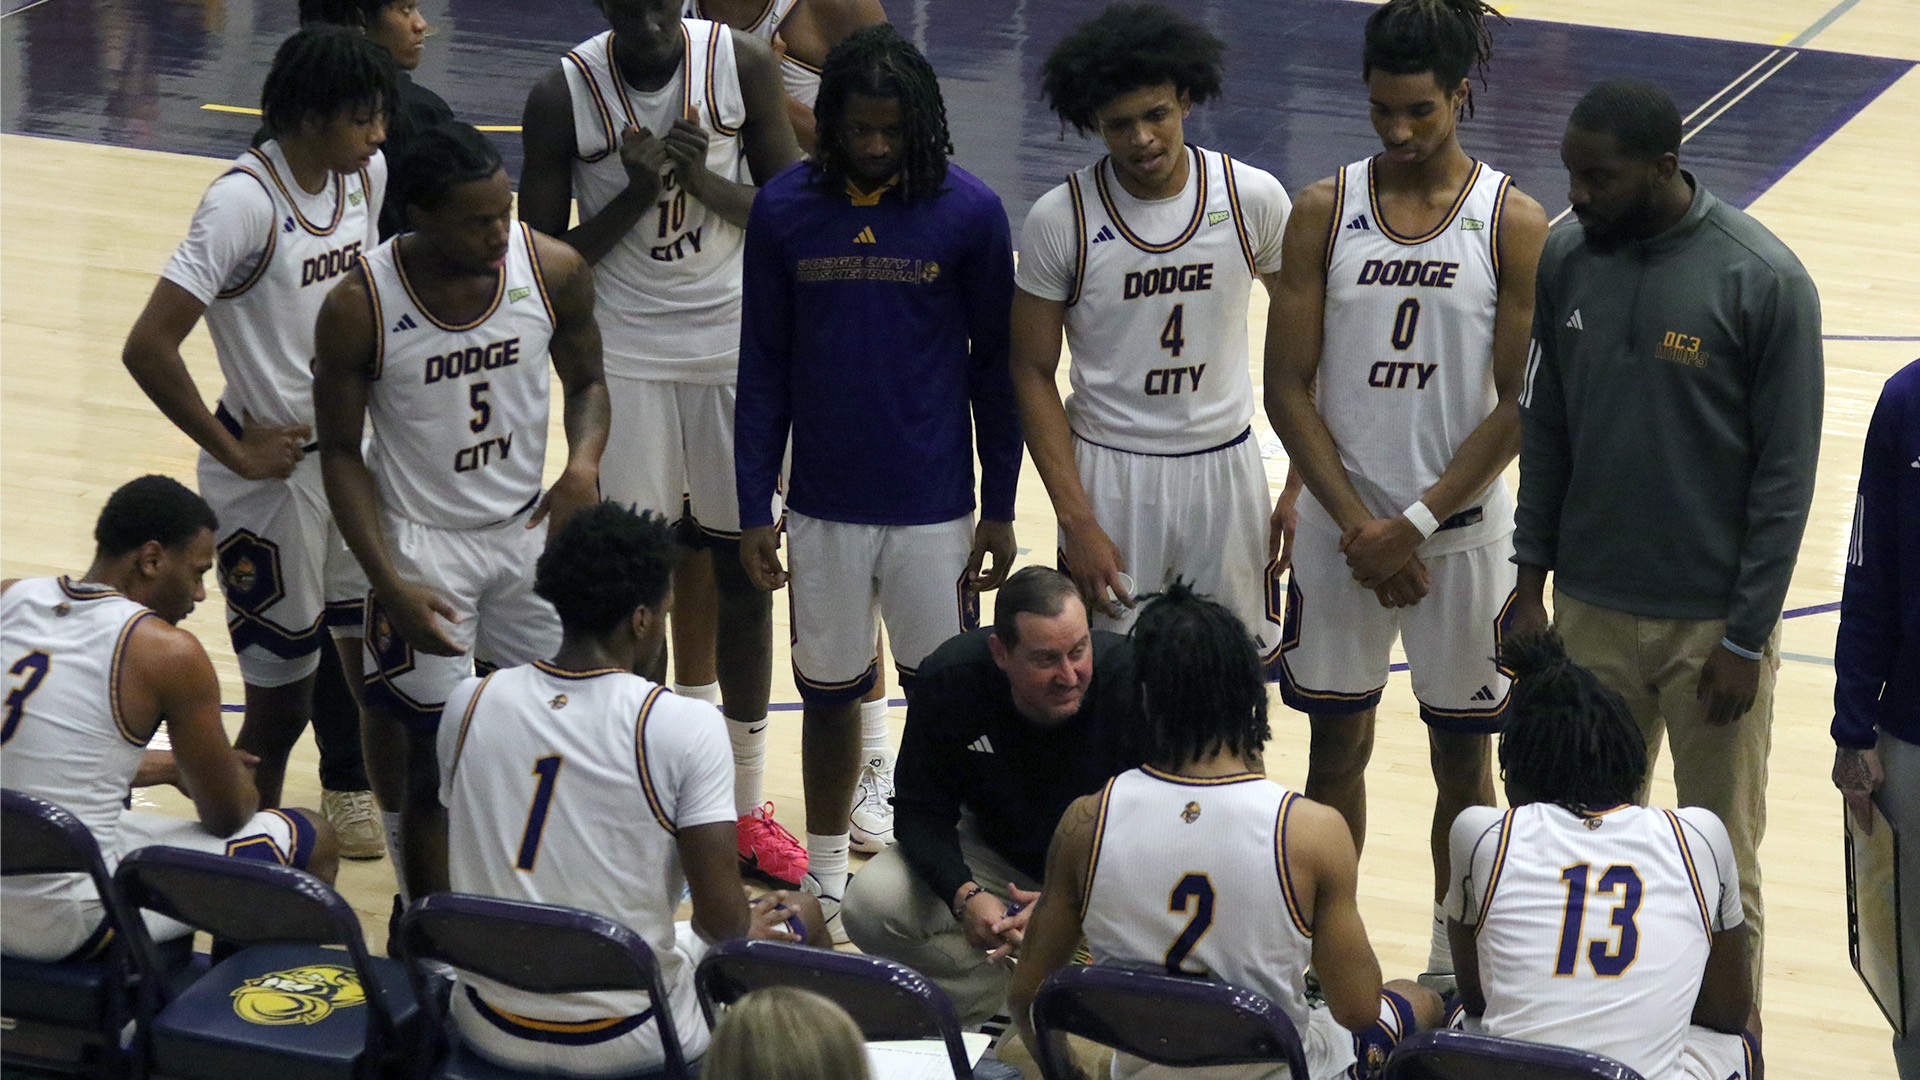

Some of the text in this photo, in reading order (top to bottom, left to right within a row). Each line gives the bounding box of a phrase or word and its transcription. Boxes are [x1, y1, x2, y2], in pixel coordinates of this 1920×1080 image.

[656, 189, 686, 239] 10
[302, 240, 361, 287] DODGE
[650, 226, 702, 262] CITY
[797, 256, 910, 270] DODGE CITY
[797, 268, 916, 283] BASKETBALL
[1123, 262, 1214, 300] DODGE
[1356, 259, 1460, 289] DODGE
[1160, 302, 1185, 358] 4
[1391, 297, 1420, 351] 0
[1663, 330, 1701, 352] DC3
[424, 337, 520, 385] DODGE
[1144, 363, 1206, 396] CITY
[1368, 361, 1438, 389] CITY
[469, 382, 491, 433] 5
[453, 432, 513, 473] CITY
[0, 649, 51, 748] 3
[515, 753, 563, 873] 1
[1164, 871, 1216, 977] 2
[1552, 862, 1645, 978] 13
